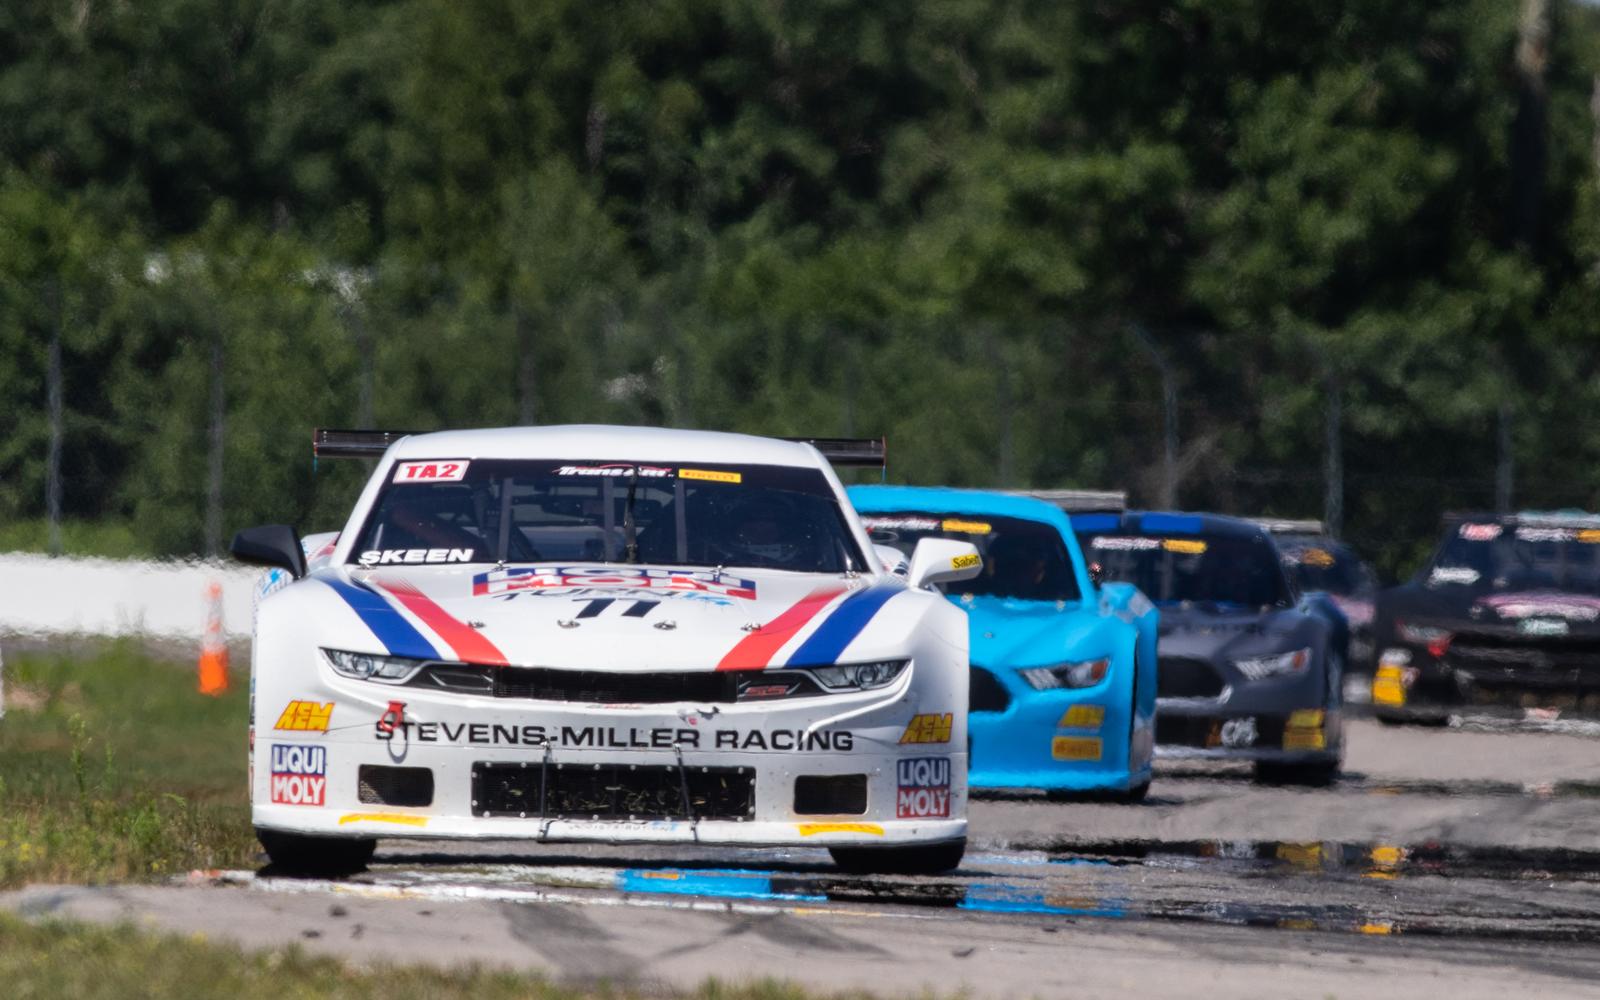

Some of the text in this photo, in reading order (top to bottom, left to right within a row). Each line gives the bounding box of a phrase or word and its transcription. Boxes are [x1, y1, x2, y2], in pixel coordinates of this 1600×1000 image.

[407, 464, 459, 478] TA2
[358, 549, 474, 564] SKEEN
[274, 700, 335, 732] AEM
[898, 713, 953, 744] AEM
[375, 720, 853, 751] STEVENS-MILLER RACING
[273, 746, 325, 775] LIQUI
[899, 759, 949, 787] LIQUI
[273, 776, 325, 805] MOLY
[899, 789, 949, 817] MOLY
